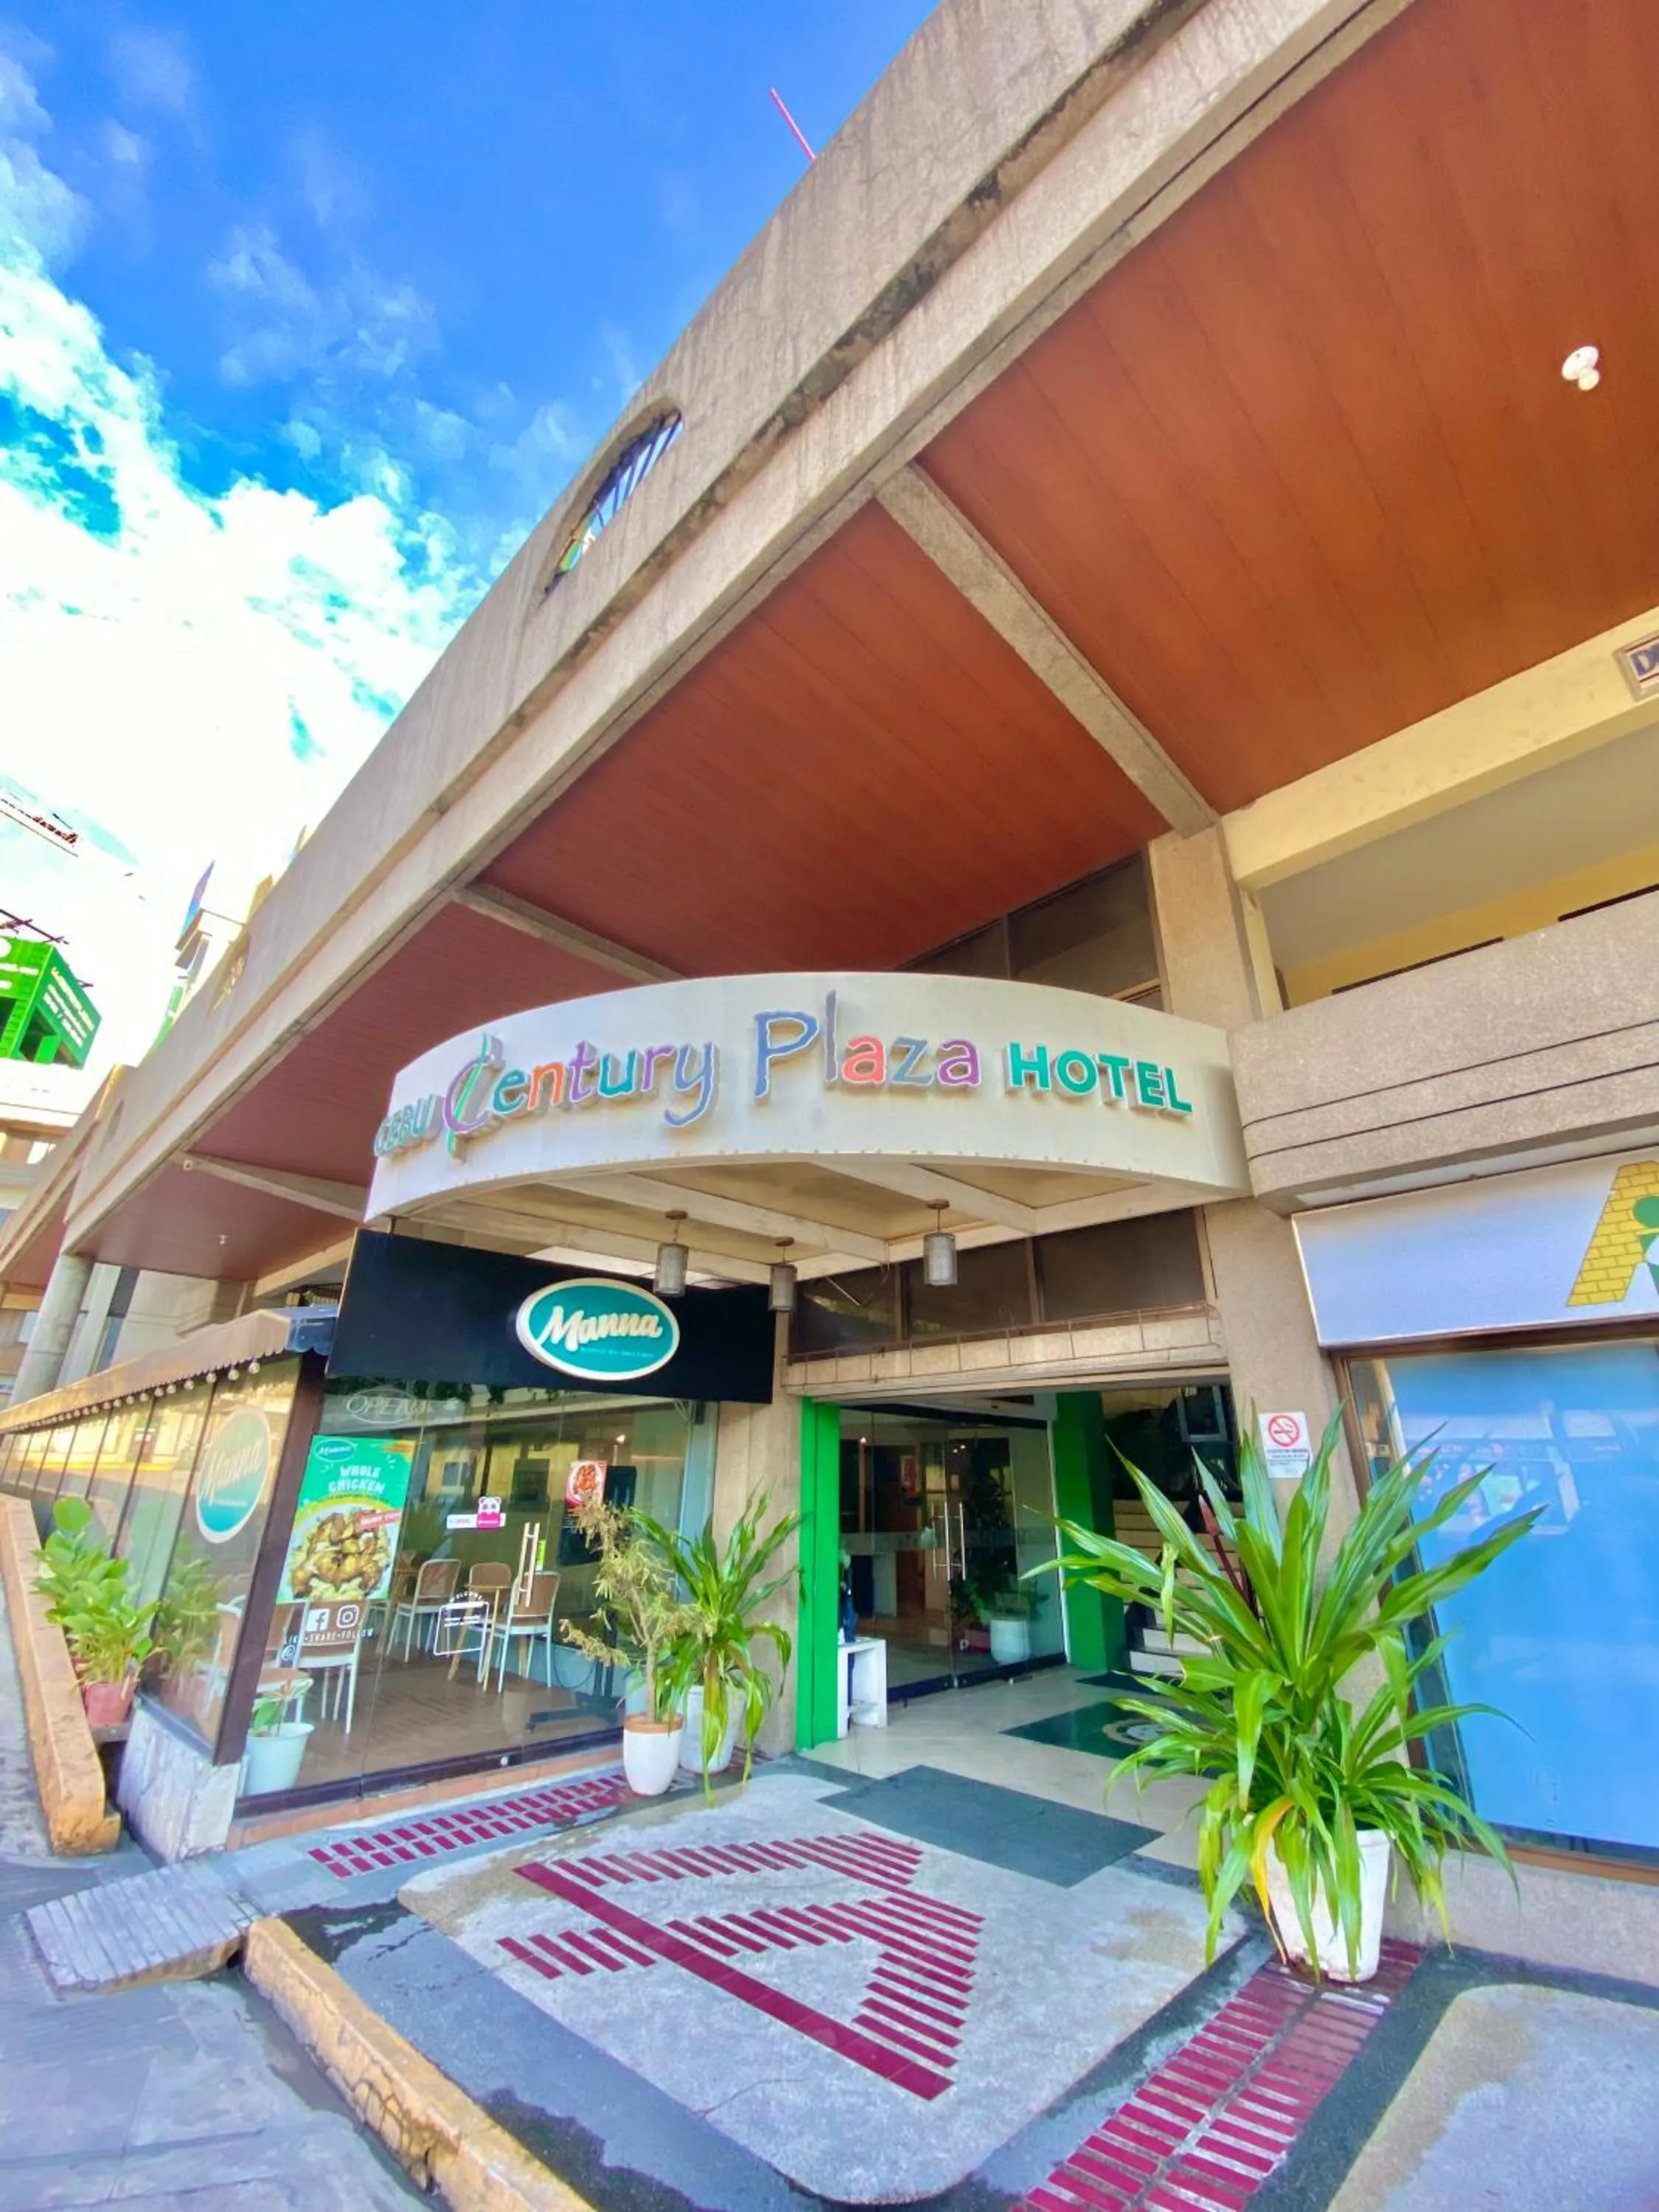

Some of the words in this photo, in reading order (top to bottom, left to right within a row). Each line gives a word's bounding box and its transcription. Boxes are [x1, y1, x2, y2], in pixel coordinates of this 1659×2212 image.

[374, 1093, 434, 1156] CEBU
[444, 1032, 714, 1158] Century
[754, 990, 980, 1099] Plaza
[1006, 1040, 1193, 1113] HOTEL
[536, 1304, 663, 1352] Manna
[328, 1478, 386, 1495] CHICKEN
[340, 1465, 381, 1478] WHOLE
